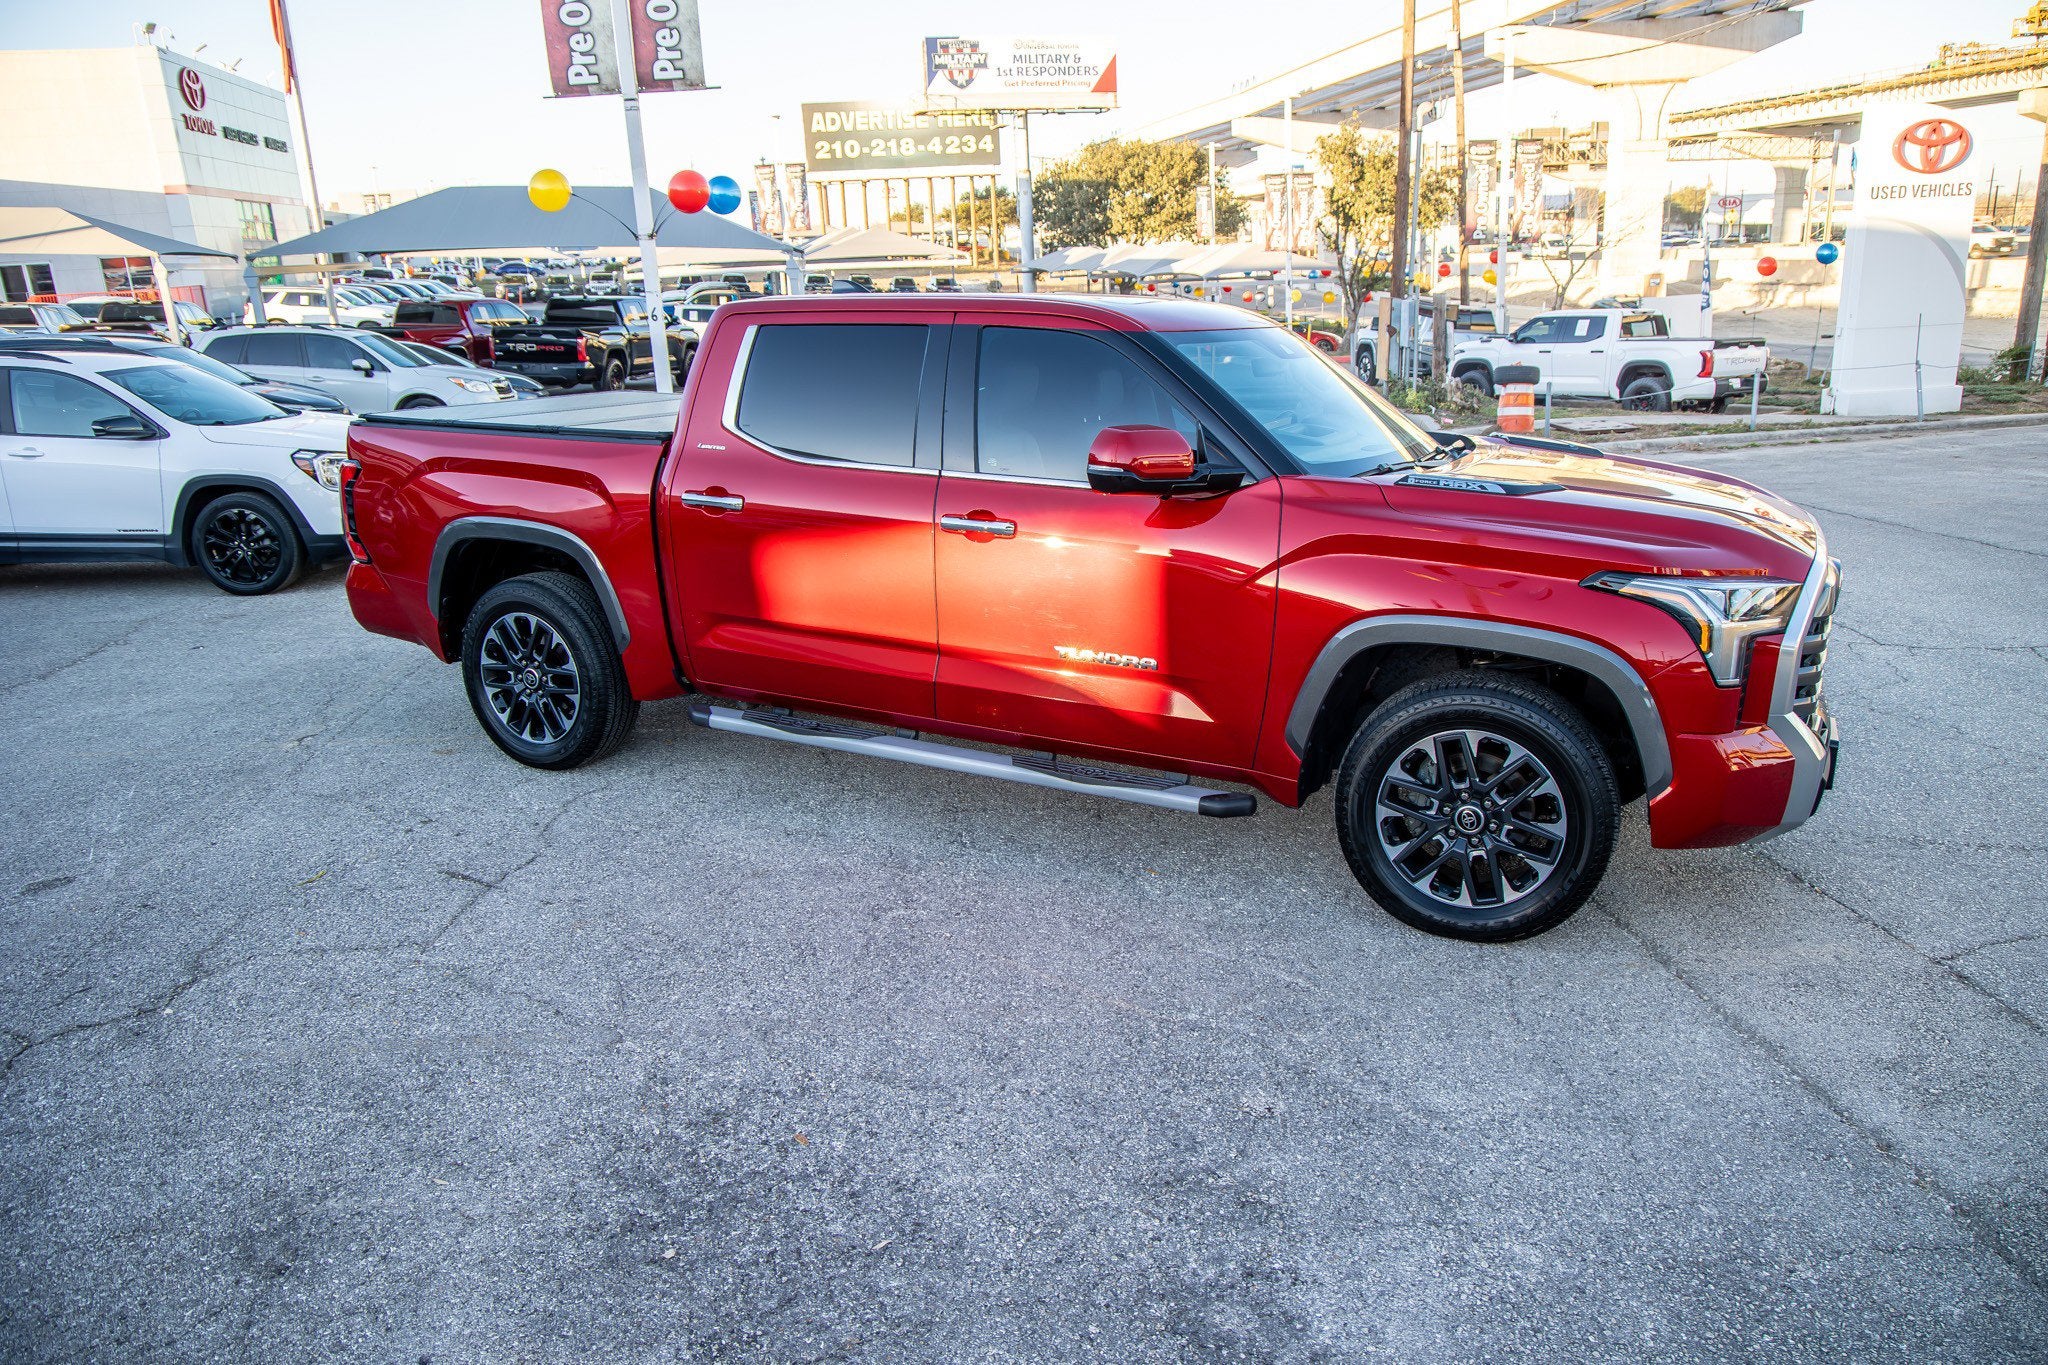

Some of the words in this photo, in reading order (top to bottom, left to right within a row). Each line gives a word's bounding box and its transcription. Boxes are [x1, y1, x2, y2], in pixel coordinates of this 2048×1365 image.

[558, 0, 592, 27] O
[567, 31, 600, 86] Pre
[653, 27, 685, 81] Pre
[933, 52, 987, 65] MILITARY
[1012, 54, 1070, 64] MILITARY
[1073, 53, 1081, 63] &
[996, 67, 1014, 77] 1st
[1017, 66, 1099, 77] RESPONDERS
[1004, 80, 1019, 88] Get
[1021, 80, 1060, 88] Preferred
[1062, 80, 1092, 88] Pricing
[181, 112, 217, 136] TOYOTA
[811, 110, 930, 133] ADVERTISE
[937, 113, 992, 128] HERE
[815, 134, 994, 159] 210-218-4234
[1474, 163, 1490, 214] Owned
[1520, 162, 1536, 213] Owned
[1870, 185, 1907, 200] USED
[1912, 182, 1973, 198] VEHICLES
[1721, 199, 1738, 207] KIA
[1473, 215, 1487, 239] Pre
[650, 308, 659, 322] 6
[506, 342, 537, 352] TRD
[1053, 645, 1159, 671] TUNDRA
